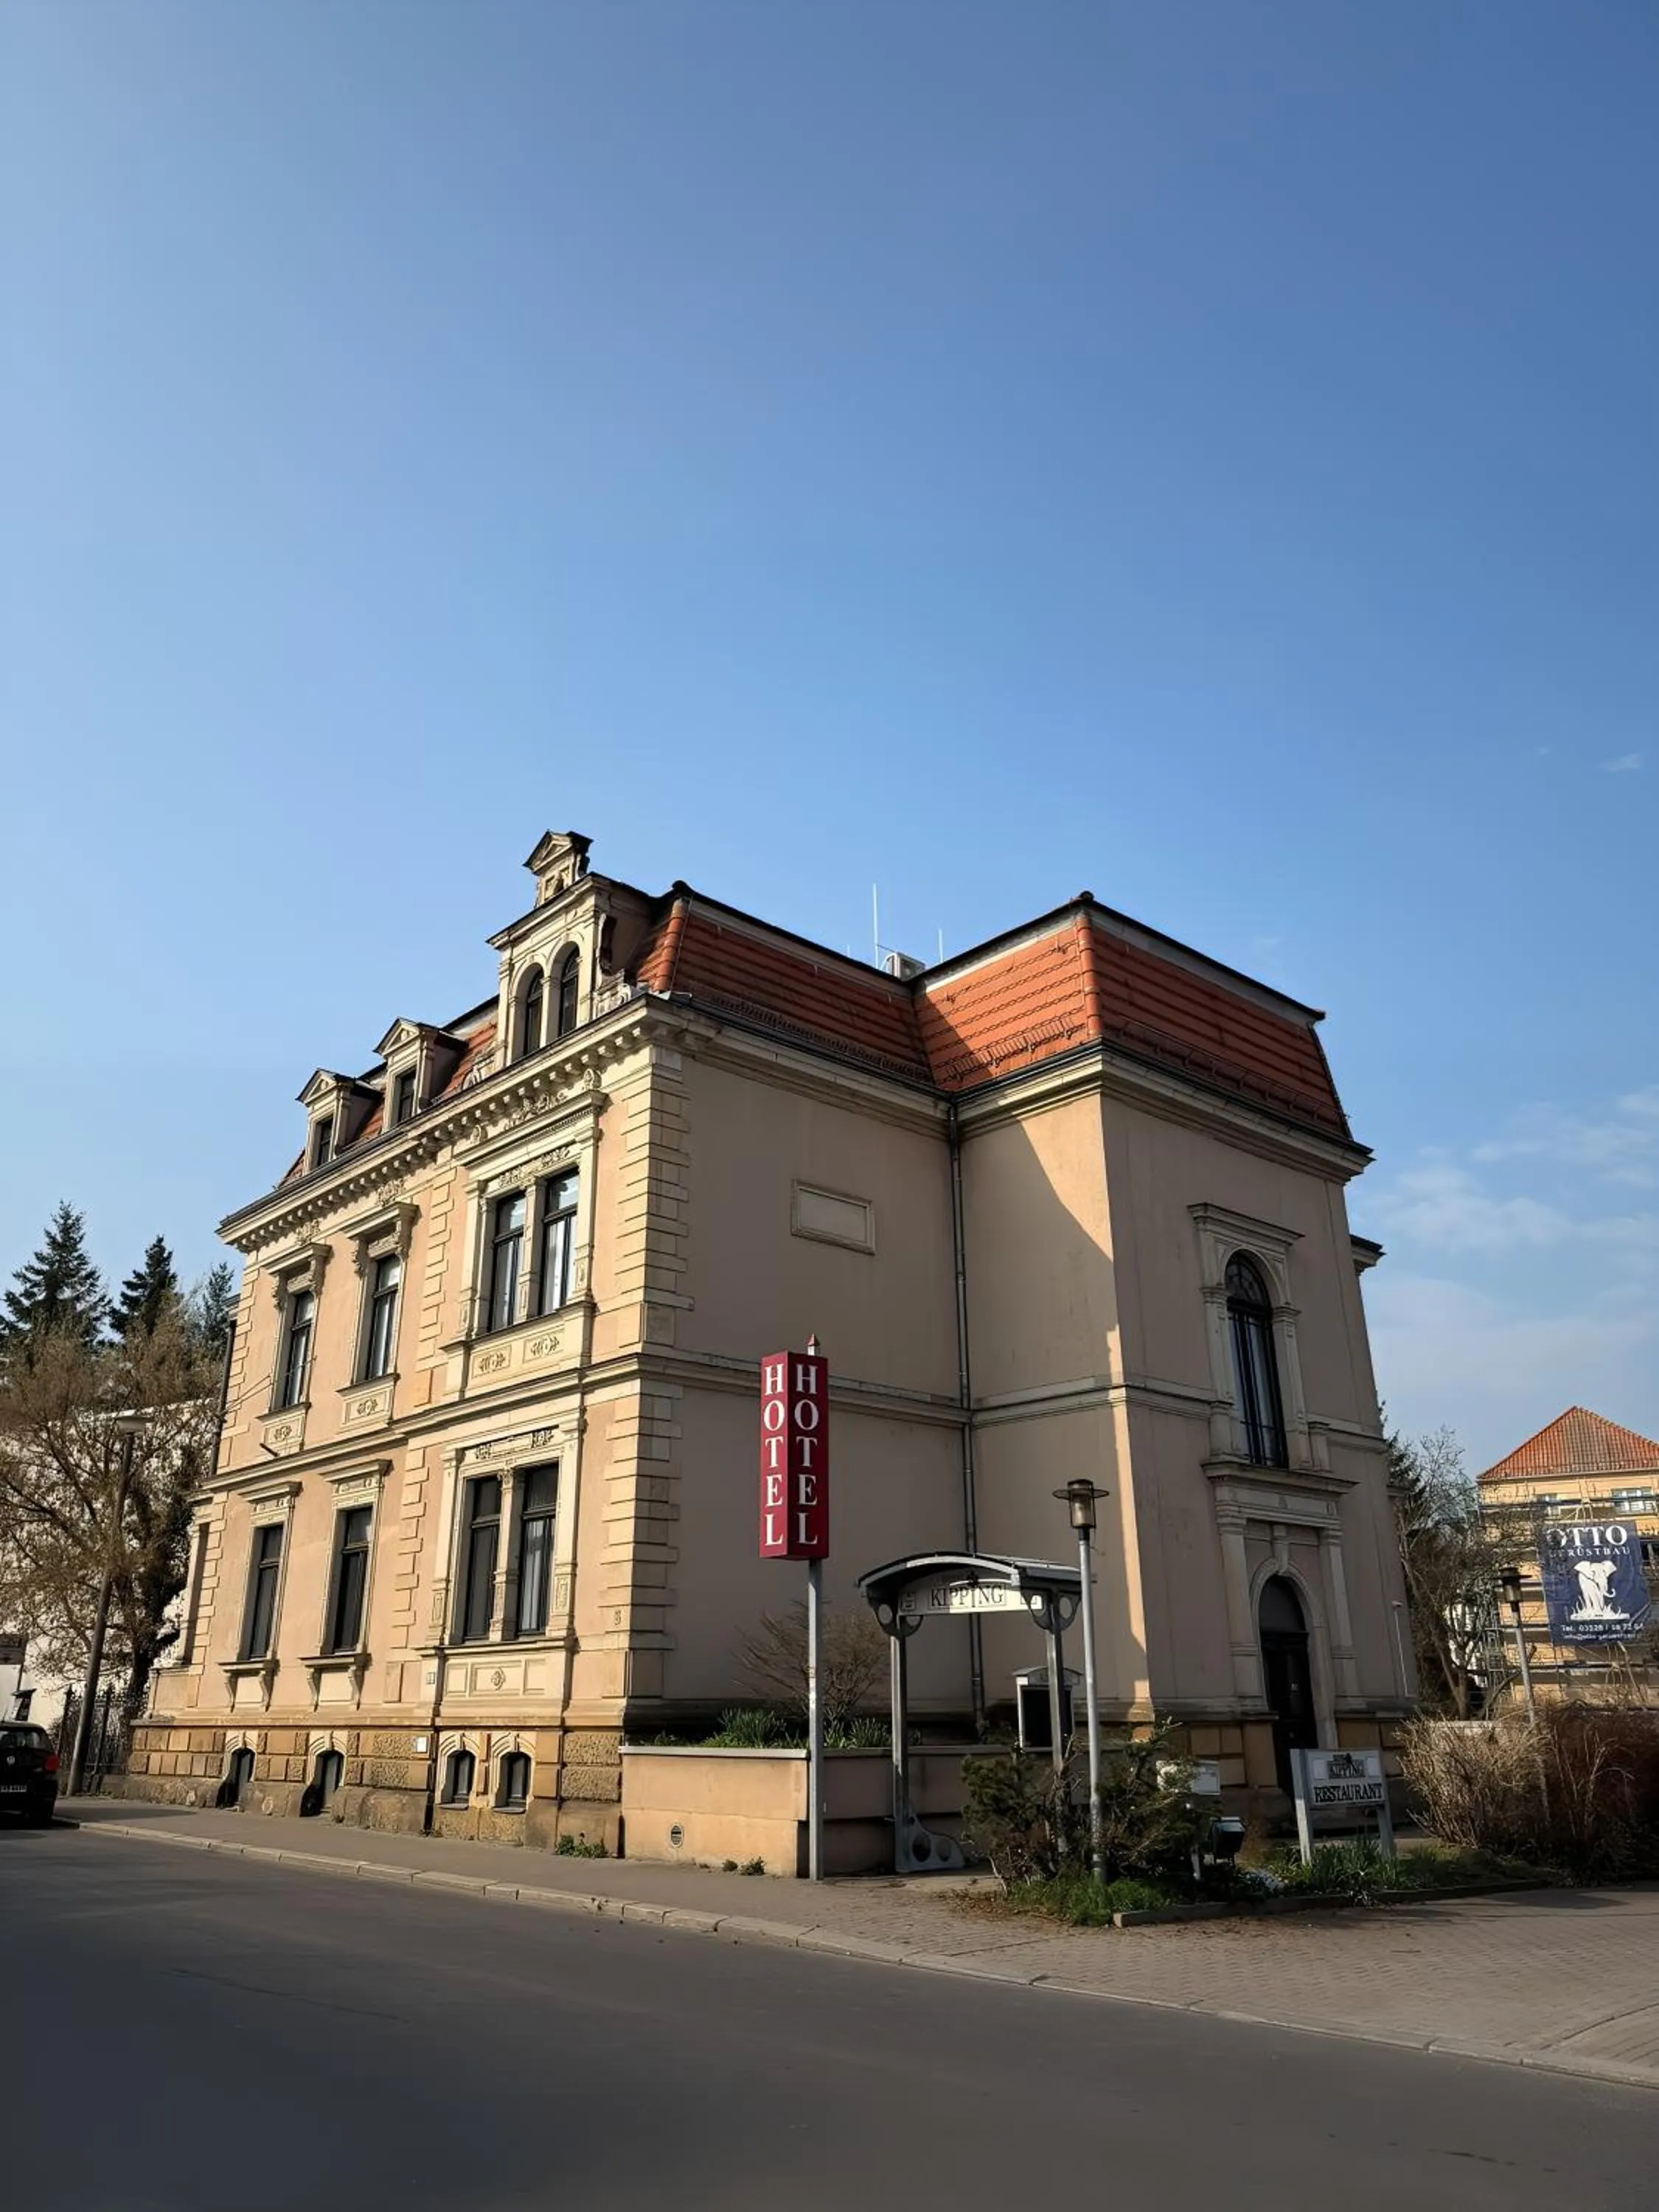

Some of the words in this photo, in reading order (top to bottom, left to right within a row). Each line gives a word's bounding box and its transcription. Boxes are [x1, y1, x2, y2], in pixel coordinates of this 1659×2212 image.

[763, 1363, 785, 1545] HOTEL
[794, 1363, 819, 1545] HOTEL
[1546, 1525, 1627, 1547] OTTO
[931, 1585, 1004, 1607] KIPPING
[1313, 1783, 1382, 1802] RESTAURANT
